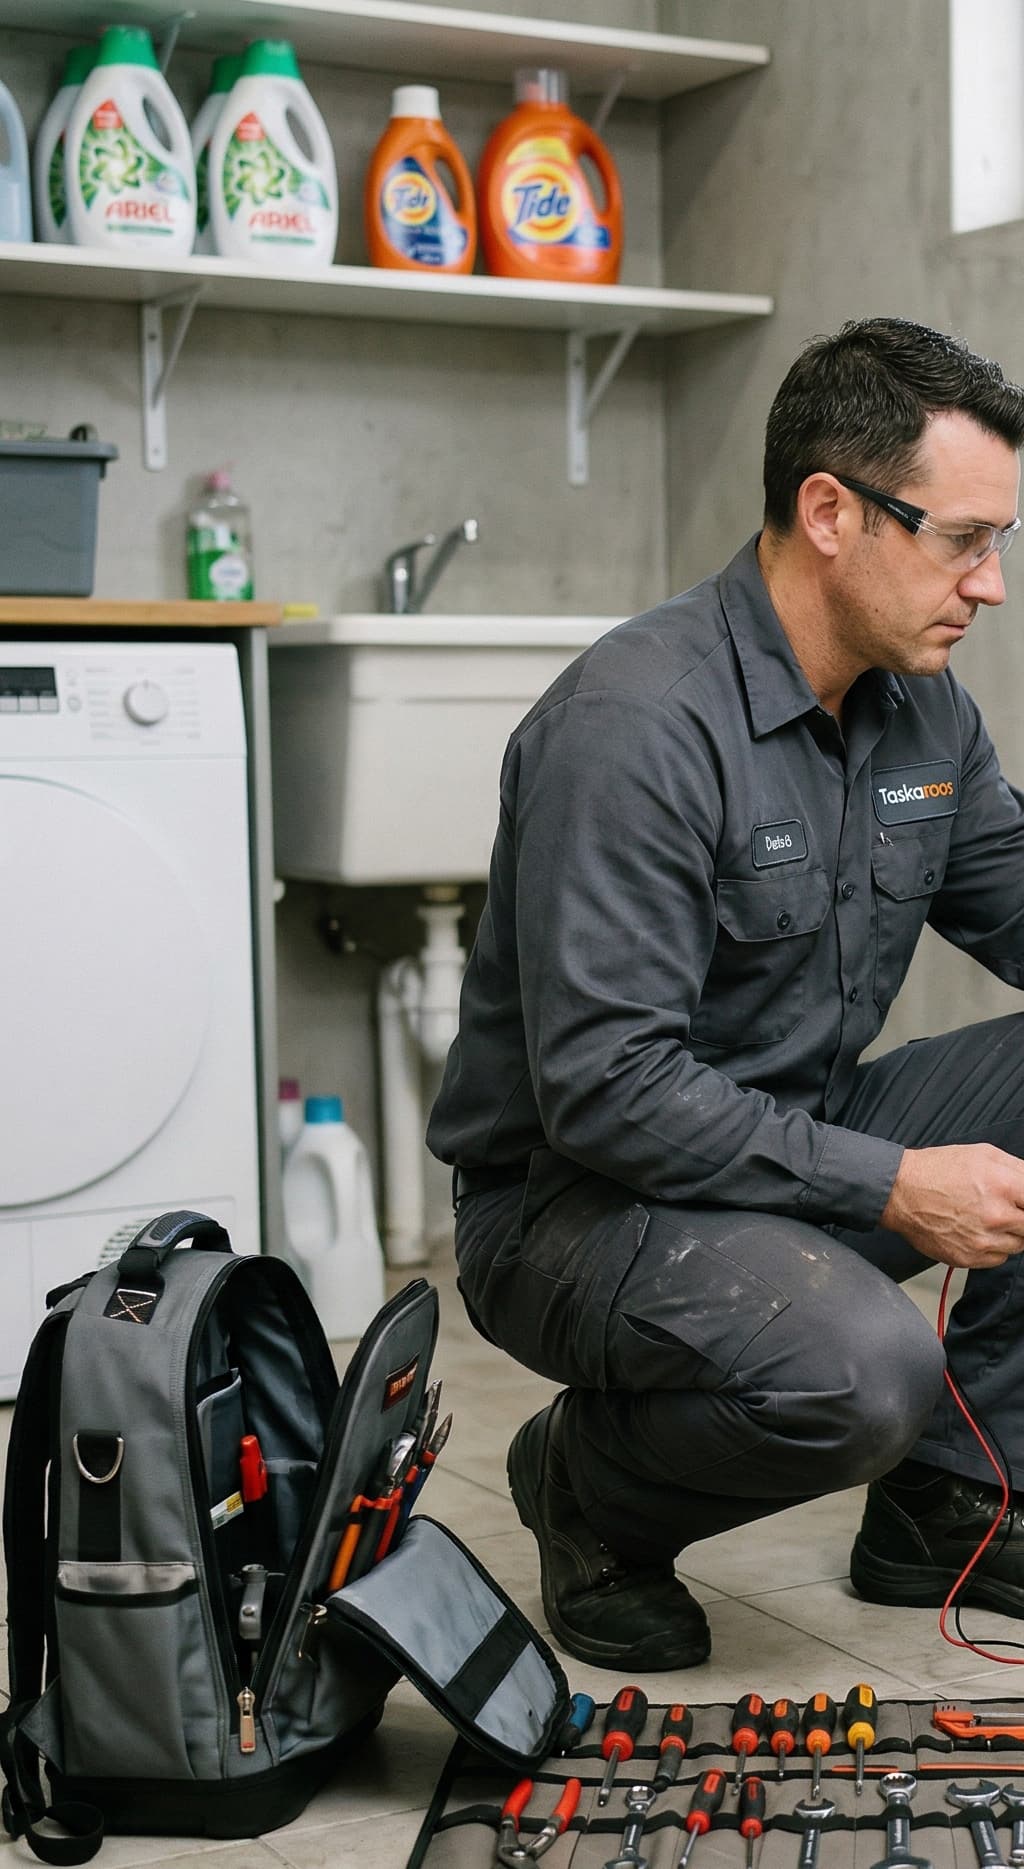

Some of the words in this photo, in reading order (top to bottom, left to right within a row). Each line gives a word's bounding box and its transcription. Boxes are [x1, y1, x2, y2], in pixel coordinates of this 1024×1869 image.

[105, 199, 175, 224] ARIEL
[513, 183, 571, 226] Tide
[249, 211, 317, 236] ARIEL
[878, 781, 954, 805] Taskaroos
